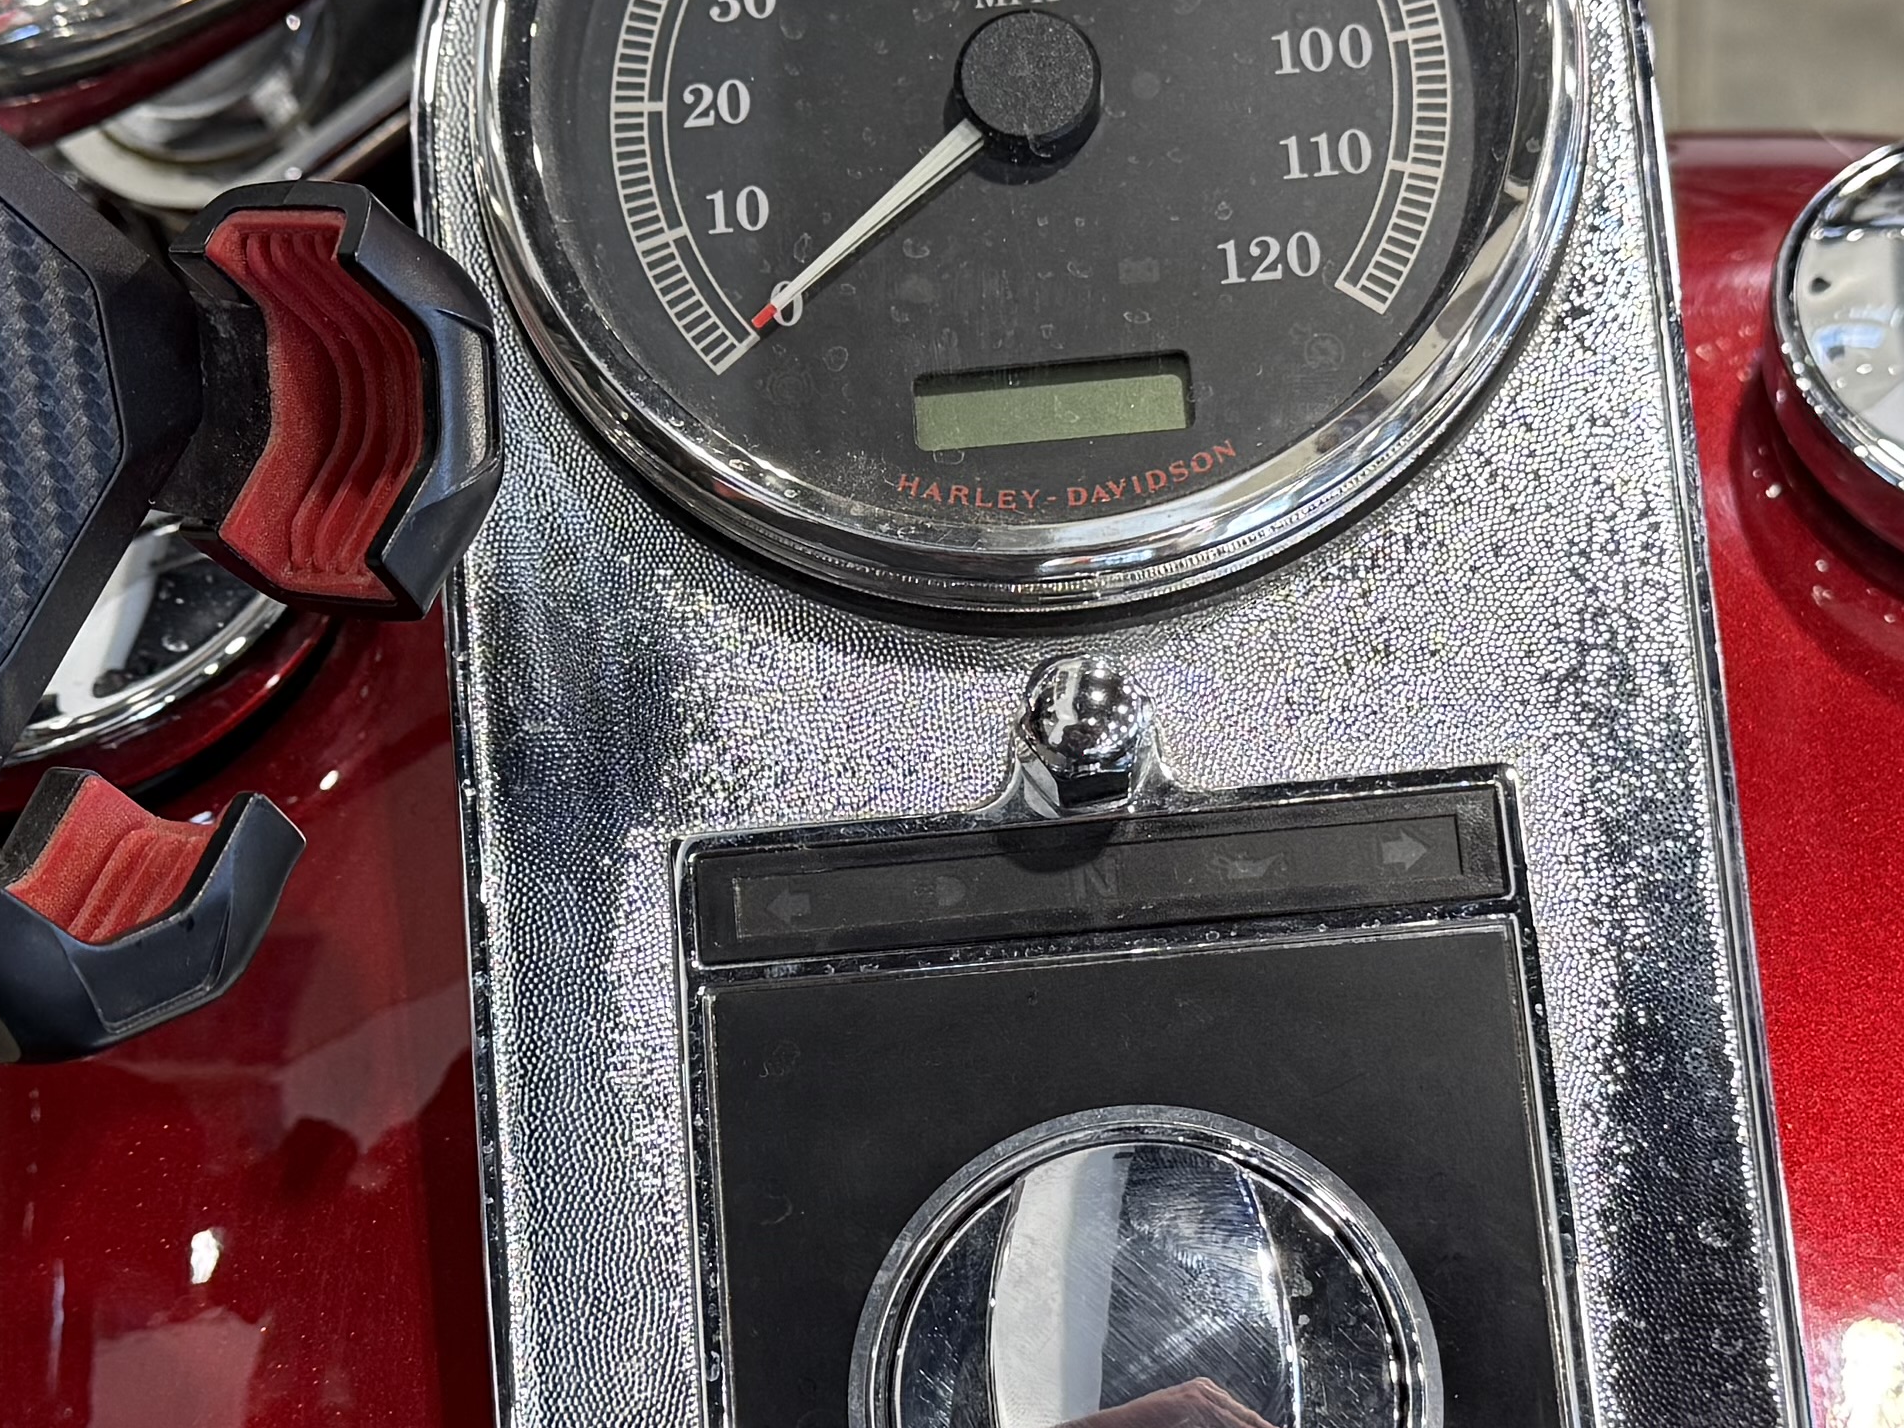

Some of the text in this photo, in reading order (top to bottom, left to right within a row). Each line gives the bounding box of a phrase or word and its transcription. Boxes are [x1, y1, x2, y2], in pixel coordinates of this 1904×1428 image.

[1270, 23, 1373, 75] 100
[682, 79, 751, 128] 20
[1279, 128, 1372, 180] 110
[705, 185, 770, 235] 10
[1216, 231, 1321, 285] 120
[897, 439, 1238, 510] HARLEY-DAVIDSON
